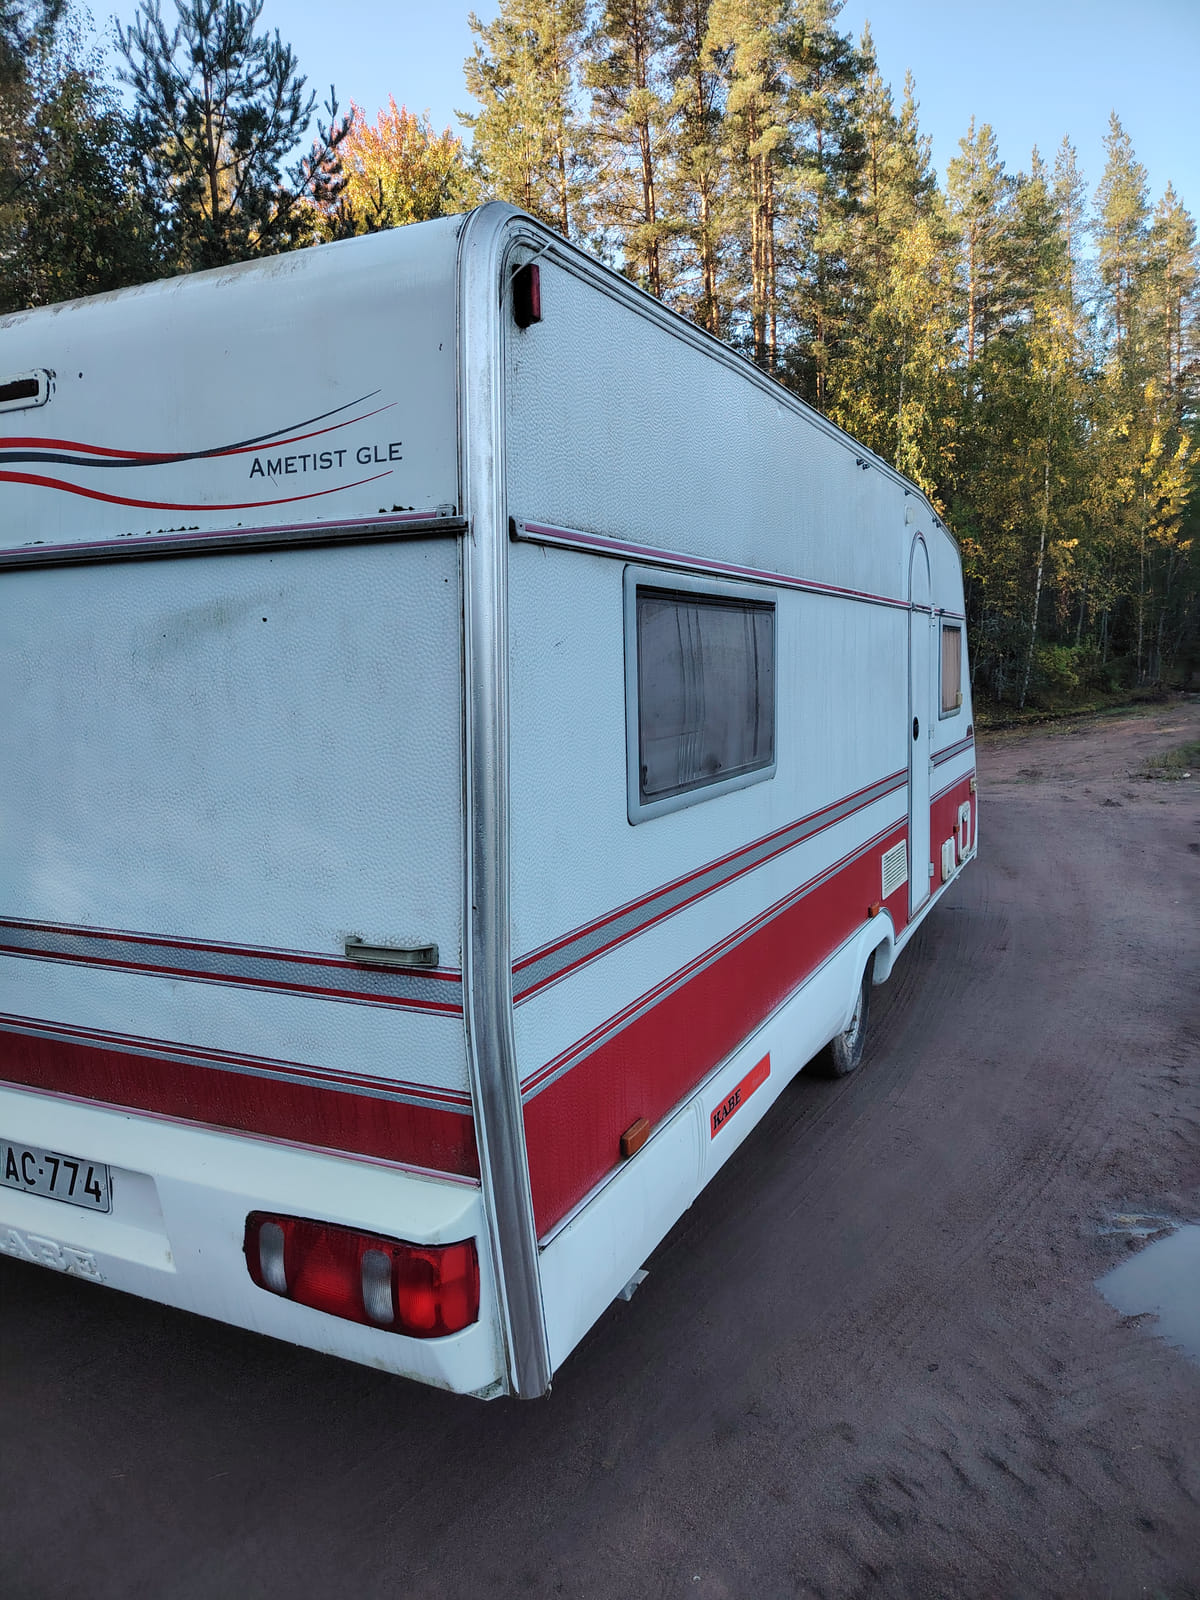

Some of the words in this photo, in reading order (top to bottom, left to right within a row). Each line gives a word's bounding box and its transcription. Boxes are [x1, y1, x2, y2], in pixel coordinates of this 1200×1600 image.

[249, 450, 347, 478] AMETIST
[356, 442, 403, 465] GLE
[713, 1088, 741, 1130] KABE
[0, 1228, 104, 1282] ABE
